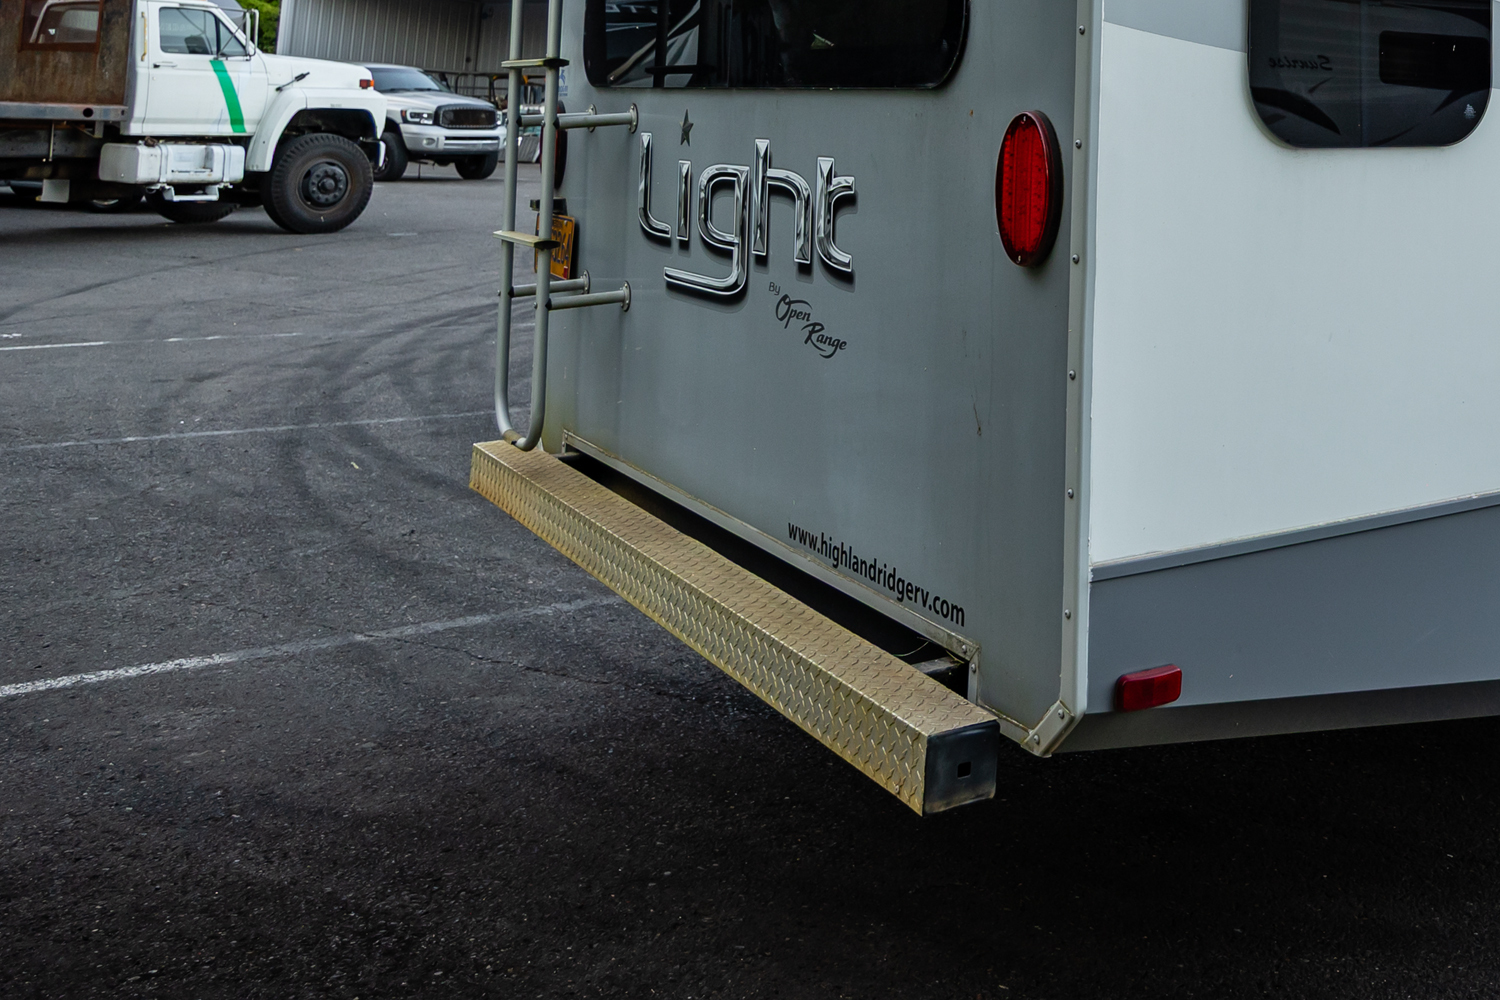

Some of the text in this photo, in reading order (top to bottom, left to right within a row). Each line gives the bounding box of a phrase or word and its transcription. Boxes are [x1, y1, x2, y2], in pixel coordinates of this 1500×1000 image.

[637, 132, 855, 296] Light
[768, 281, 781, 296] By
[775, 293, 813, 330] Open
[801, 322, 848, 359] Range
[788, 522, 966, 628] www.highlandridgerv.com
